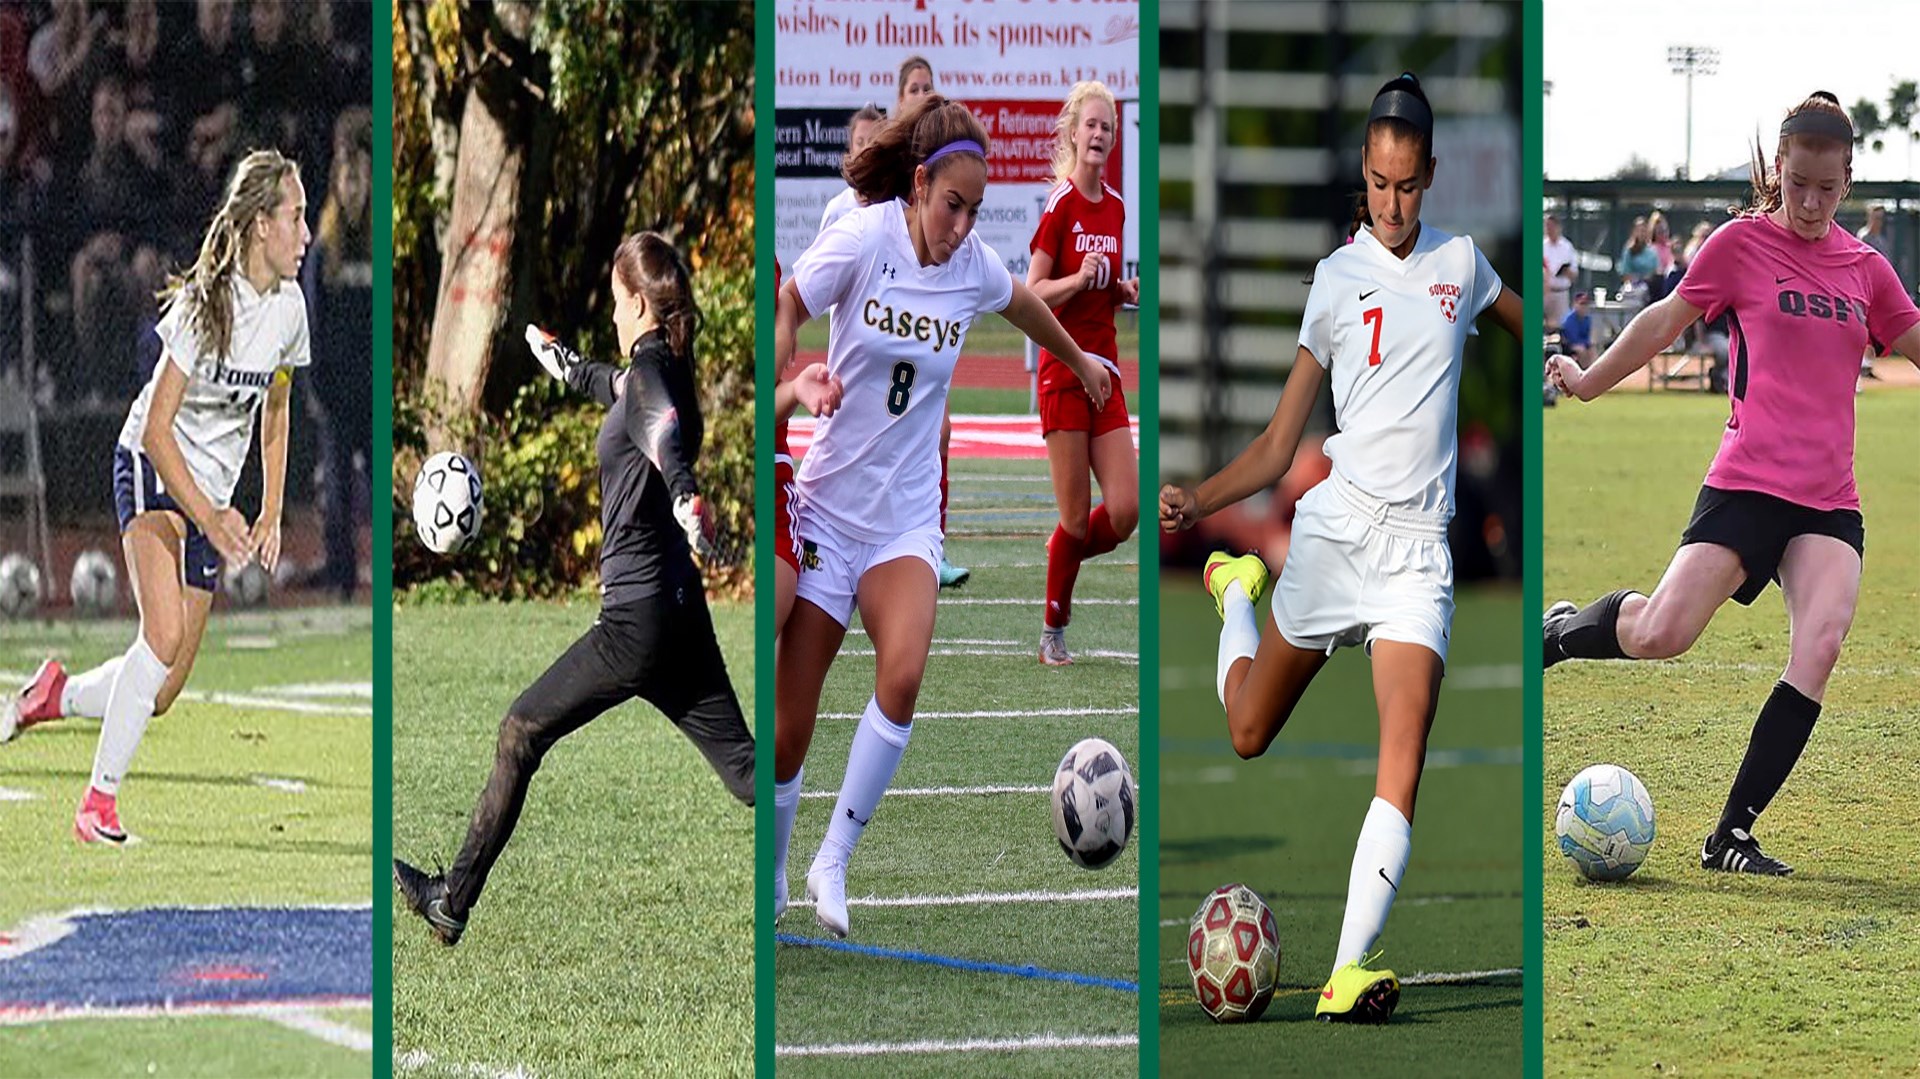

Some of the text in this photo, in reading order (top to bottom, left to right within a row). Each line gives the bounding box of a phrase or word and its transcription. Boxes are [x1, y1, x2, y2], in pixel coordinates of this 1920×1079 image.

[777, 5, 840, 34] wishes
[845, 17, 868, 46] to
[875, 12, 944, 46] thank
[953, 14, 980, 46] its
[987, 23, 1093, 56] sponsors
[829, 67, 861, 89] log
[869, 72, 894, 86] on
[775, 126, 802, 144] ern
[775, 148, 802, 167] sical
[1075, 233, 1117, 254] OCEAN
[1429, 284, 1461, 299] SOMERS
[864, 299, 961, 352] Caseys
[1363, 307, 1383, 367] 7
[885, 360, 918, 418] 8
